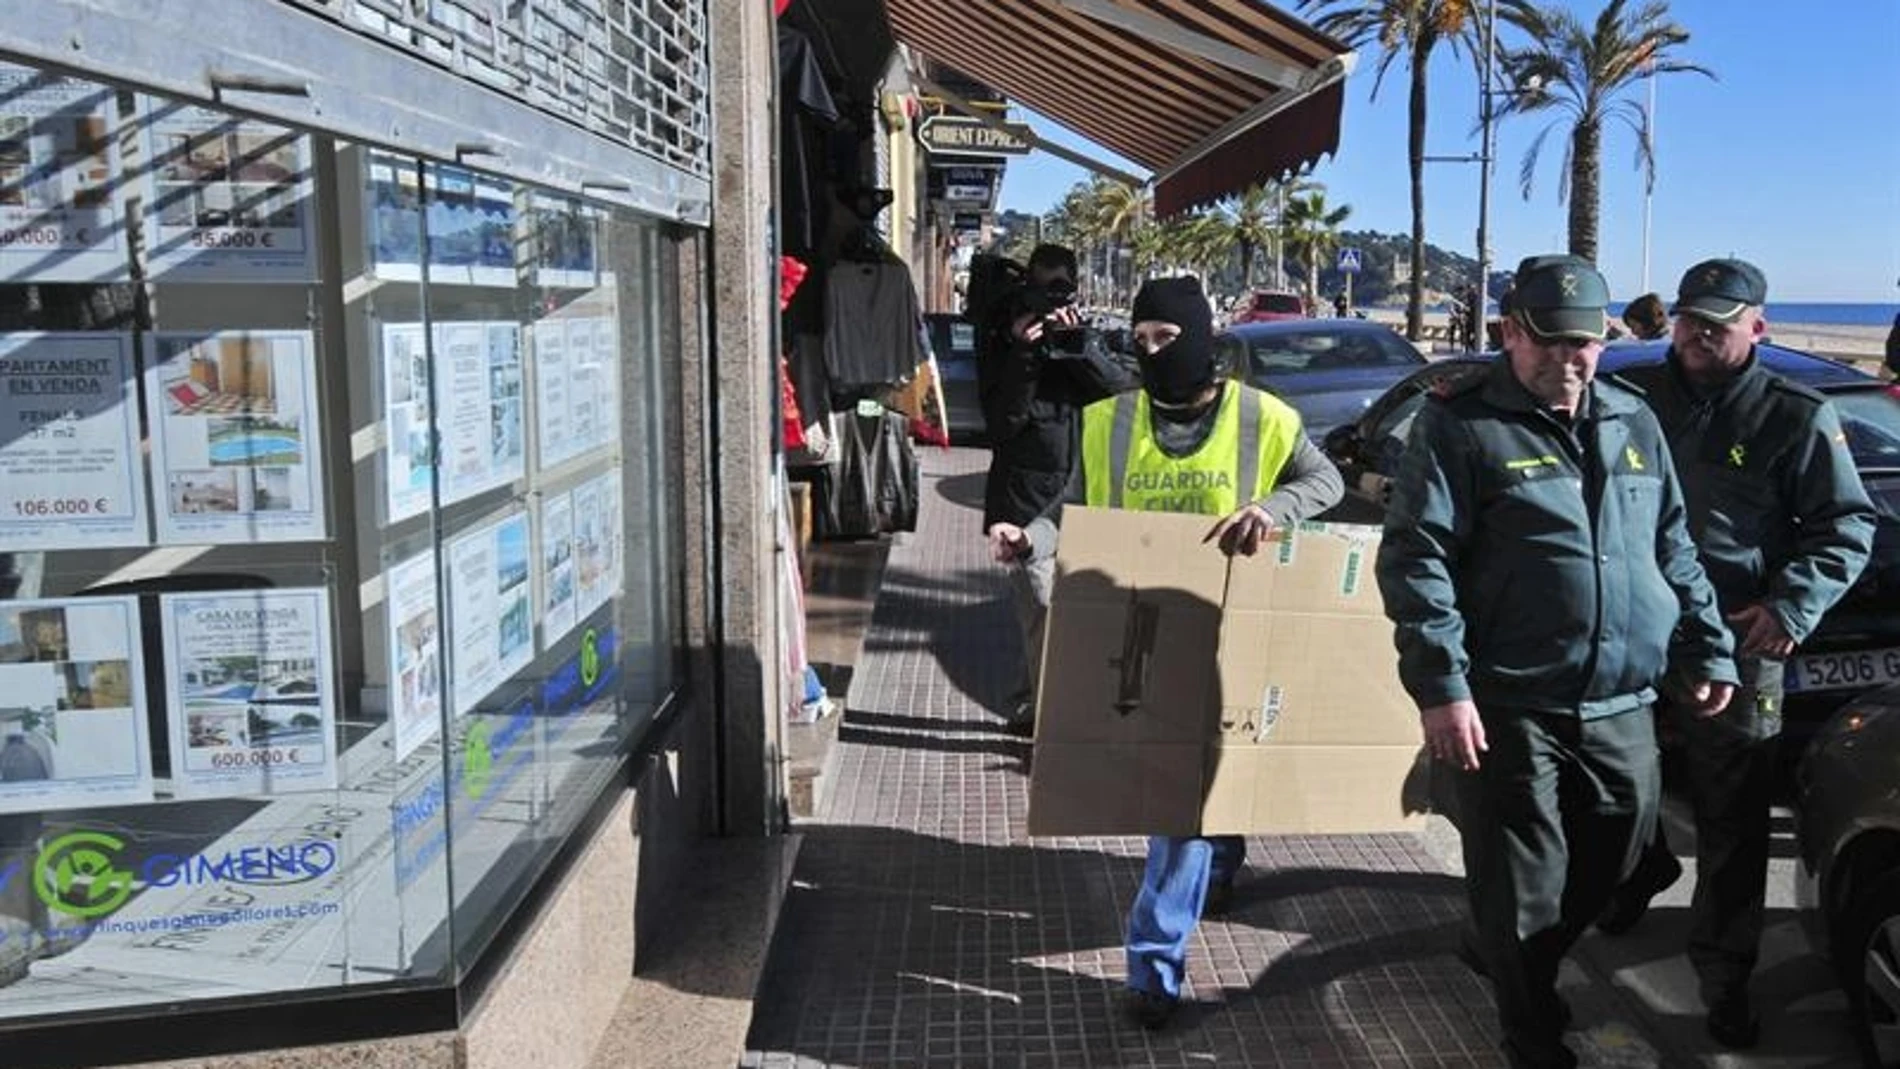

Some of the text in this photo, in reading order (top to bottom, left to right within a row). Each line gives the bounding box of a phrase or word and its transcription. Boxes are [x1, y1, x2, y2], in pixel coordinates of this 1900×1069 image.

[39, 376, 103, 394] VENDA
[1127, 467, 1232, 492] GUARDIA
[14, 497, 110, 516] 106.000 €
[1804, 653, 1875, 686] 5206
[211, 747, 300, 768] 600.000 €
[141, 842, 336, 888] GIMENO
